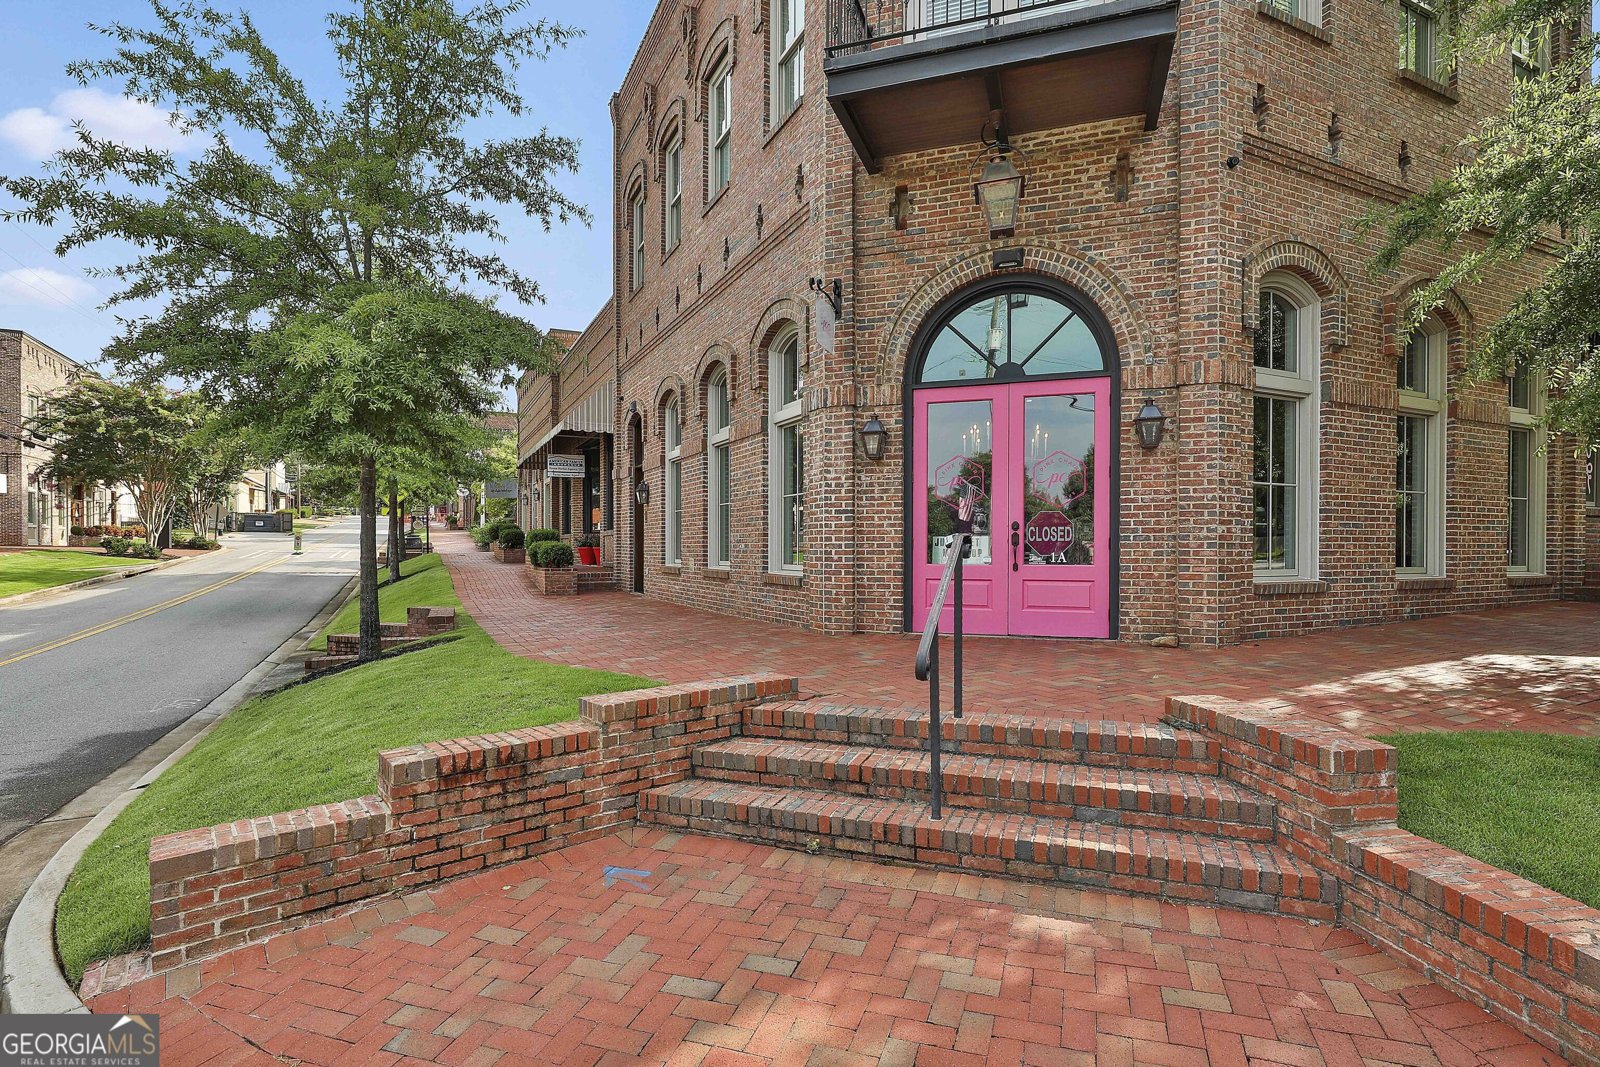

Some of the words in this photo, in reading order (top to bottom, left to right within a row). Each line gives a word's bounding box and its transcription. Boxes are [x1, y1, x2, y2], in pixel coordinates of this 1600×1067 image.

[1039, 459, 1054, 472] PINK
[1058, 457, 1080, 471] CHAIR
[1028, 526, 1072, 542] CLOSED
[1050, 552, 1067, 563] 1A
